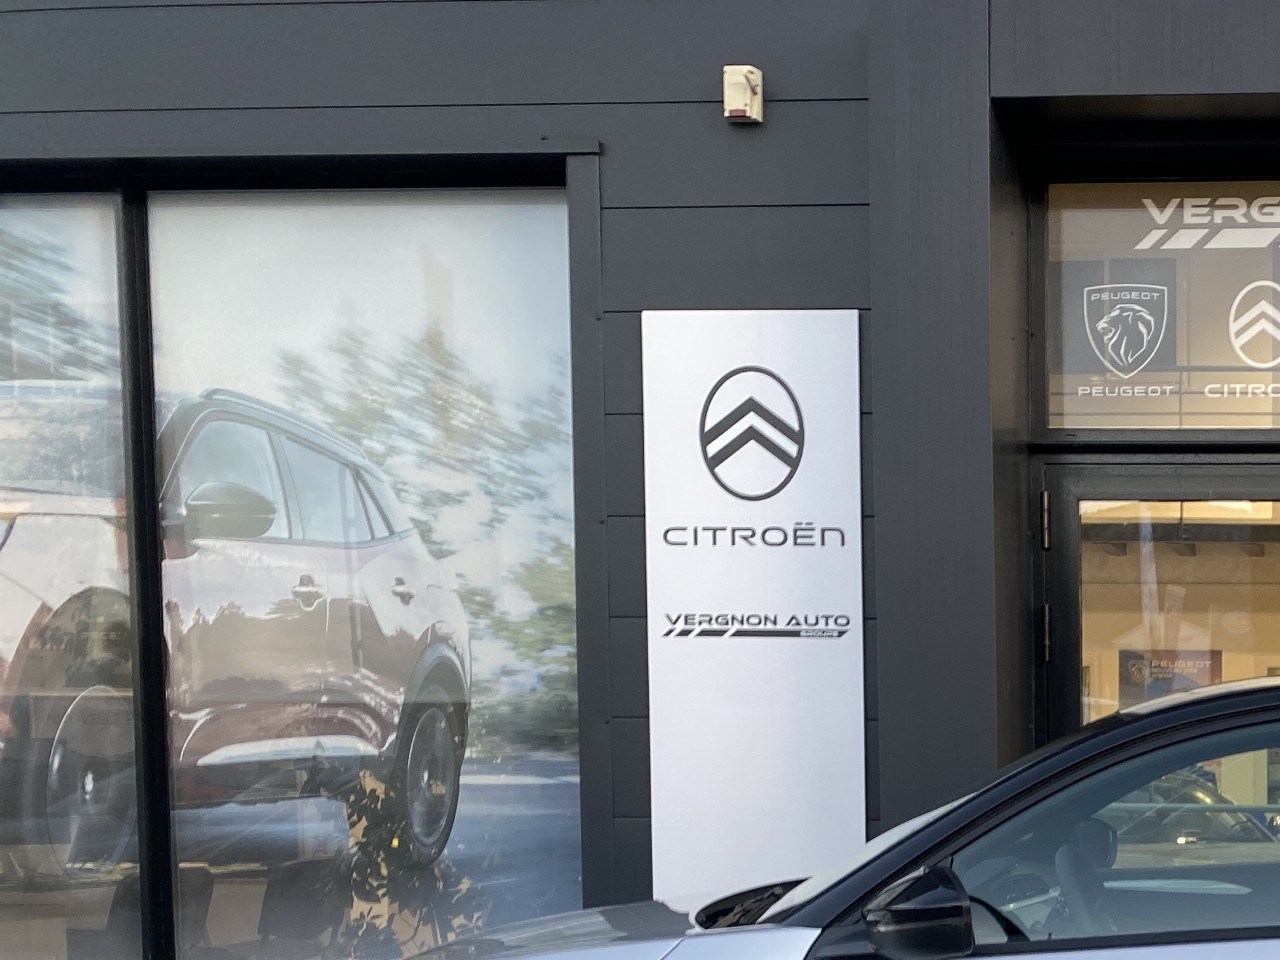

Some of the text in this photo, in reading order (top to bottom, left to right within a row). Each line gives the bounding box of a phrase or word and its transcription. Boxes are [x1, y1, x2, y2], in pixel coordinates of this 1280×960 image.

[1091, 291, 1160, 301] PEUGEOT
[1077, 385, 1174, 397] PEUGEOT
[665, 613, 851, 627] VERGNON AUTO
